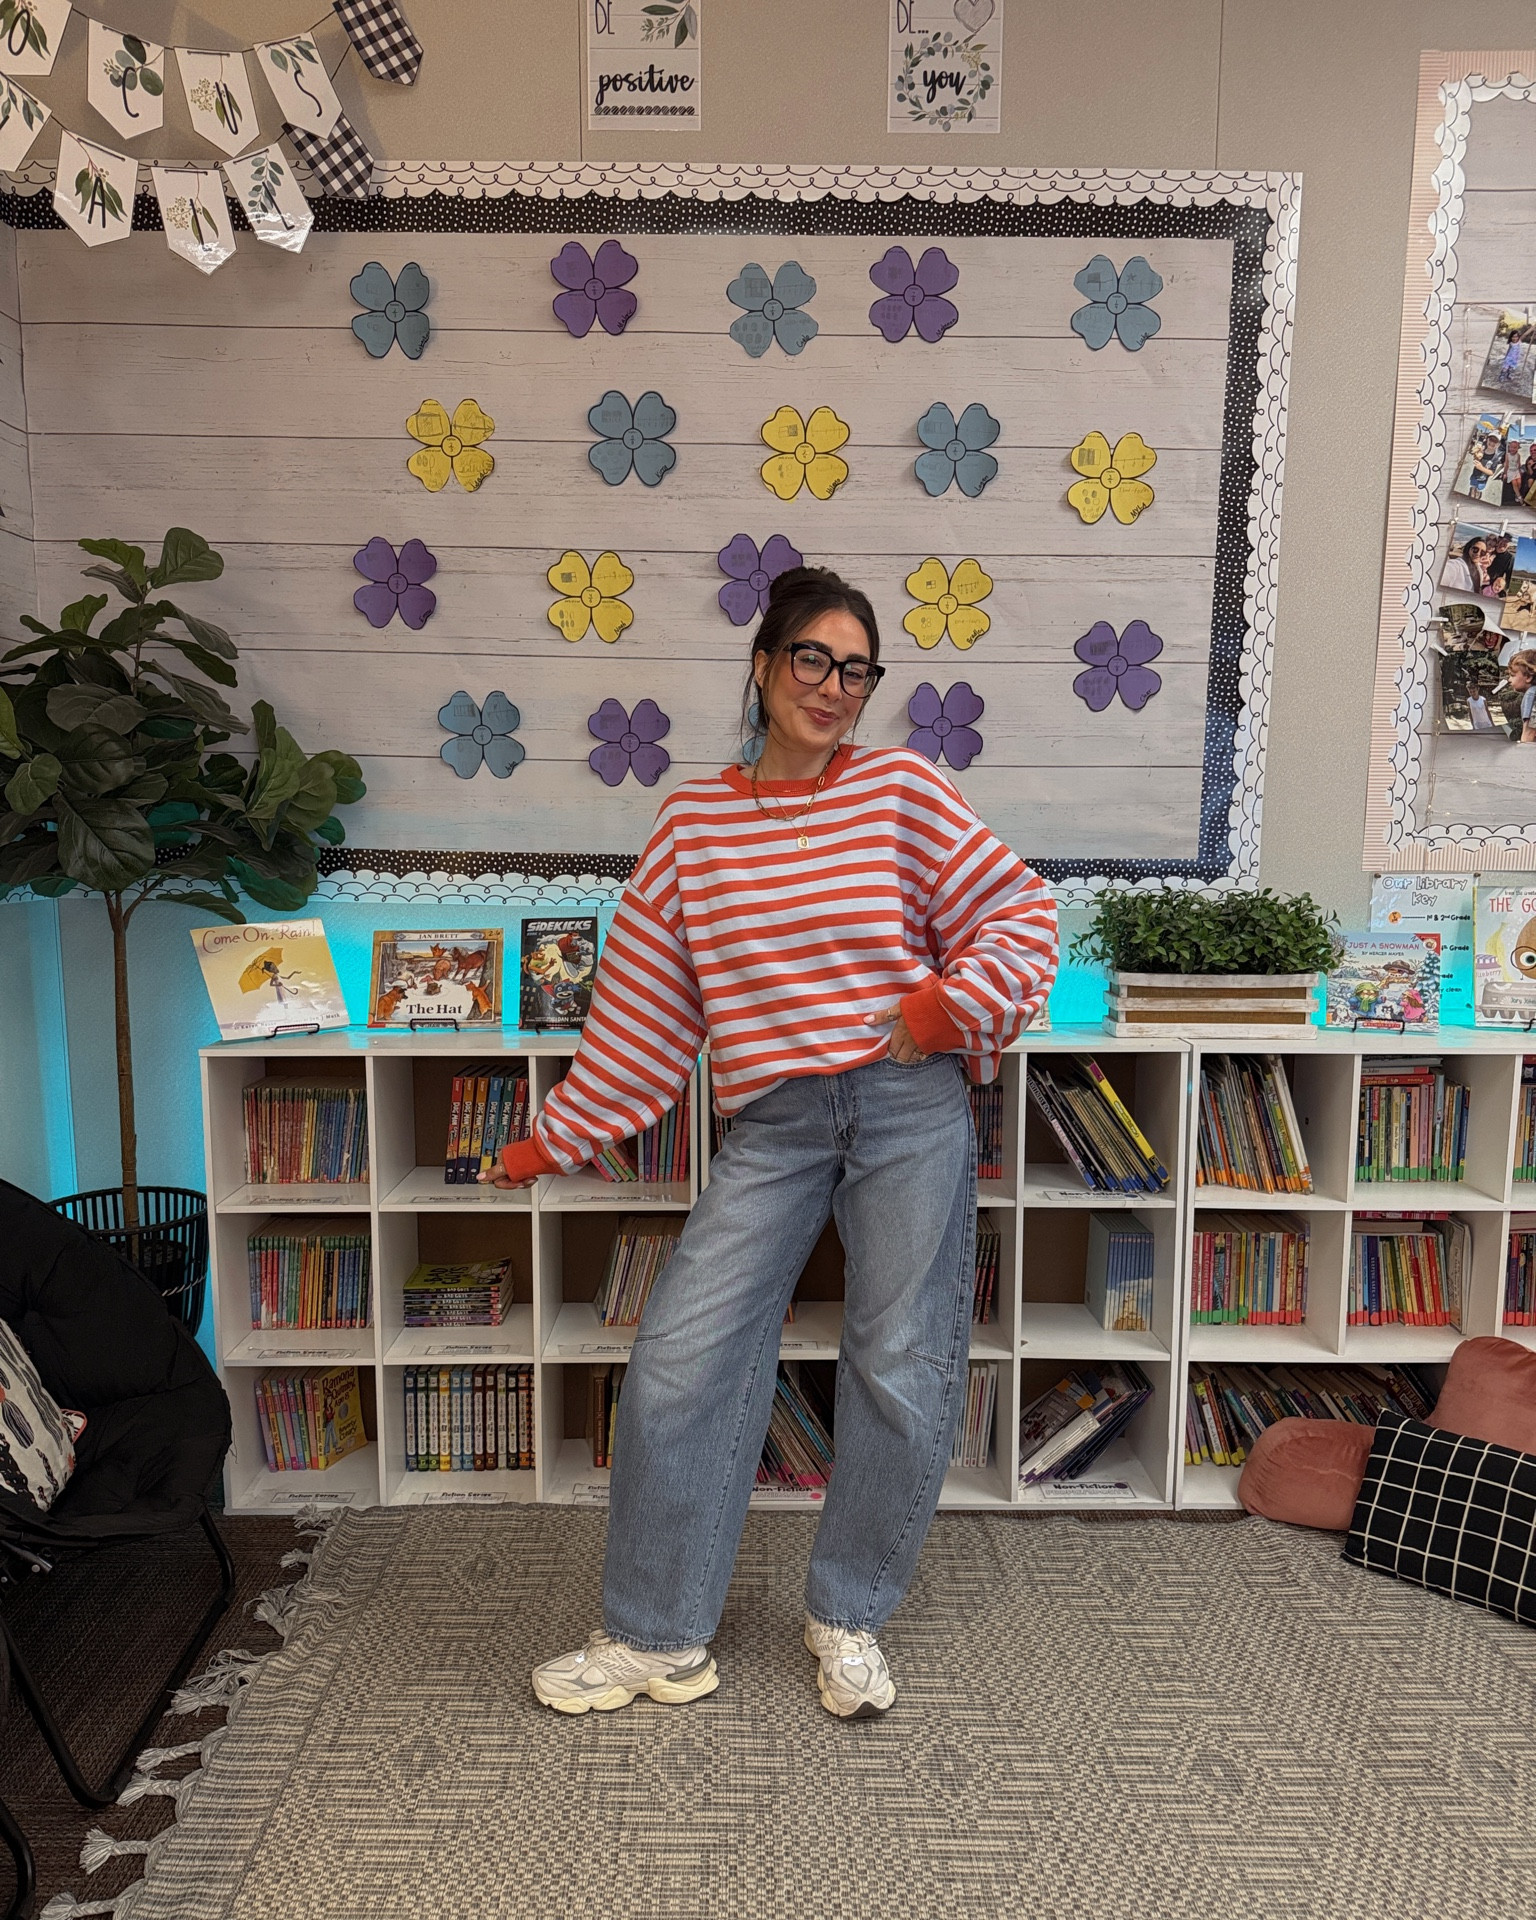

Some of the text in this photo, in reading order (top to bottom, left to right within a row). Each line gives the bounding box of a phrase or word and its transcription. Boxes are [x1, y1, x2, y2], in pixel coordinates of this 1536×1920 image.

[594, 64, 695, 106] positive
[923, 69, 967, 103] you
[966, 627, 984, 644] Bradley
[1382, 876, 1467, 891] Our Library
[1411, 892, 1438, 907] Key
[1489, 897, 1513, 913] THE
[202, 930, 241, 954] Come
[280, 921, 316, 940] Rain!
[1347, 942, 1368, 950] JUST
[1379, 942, 1420, 950] SNOWMAN
[406, 1003, 463, 1014] The Hat
[322, 1367, 355, 1394] Ramona
